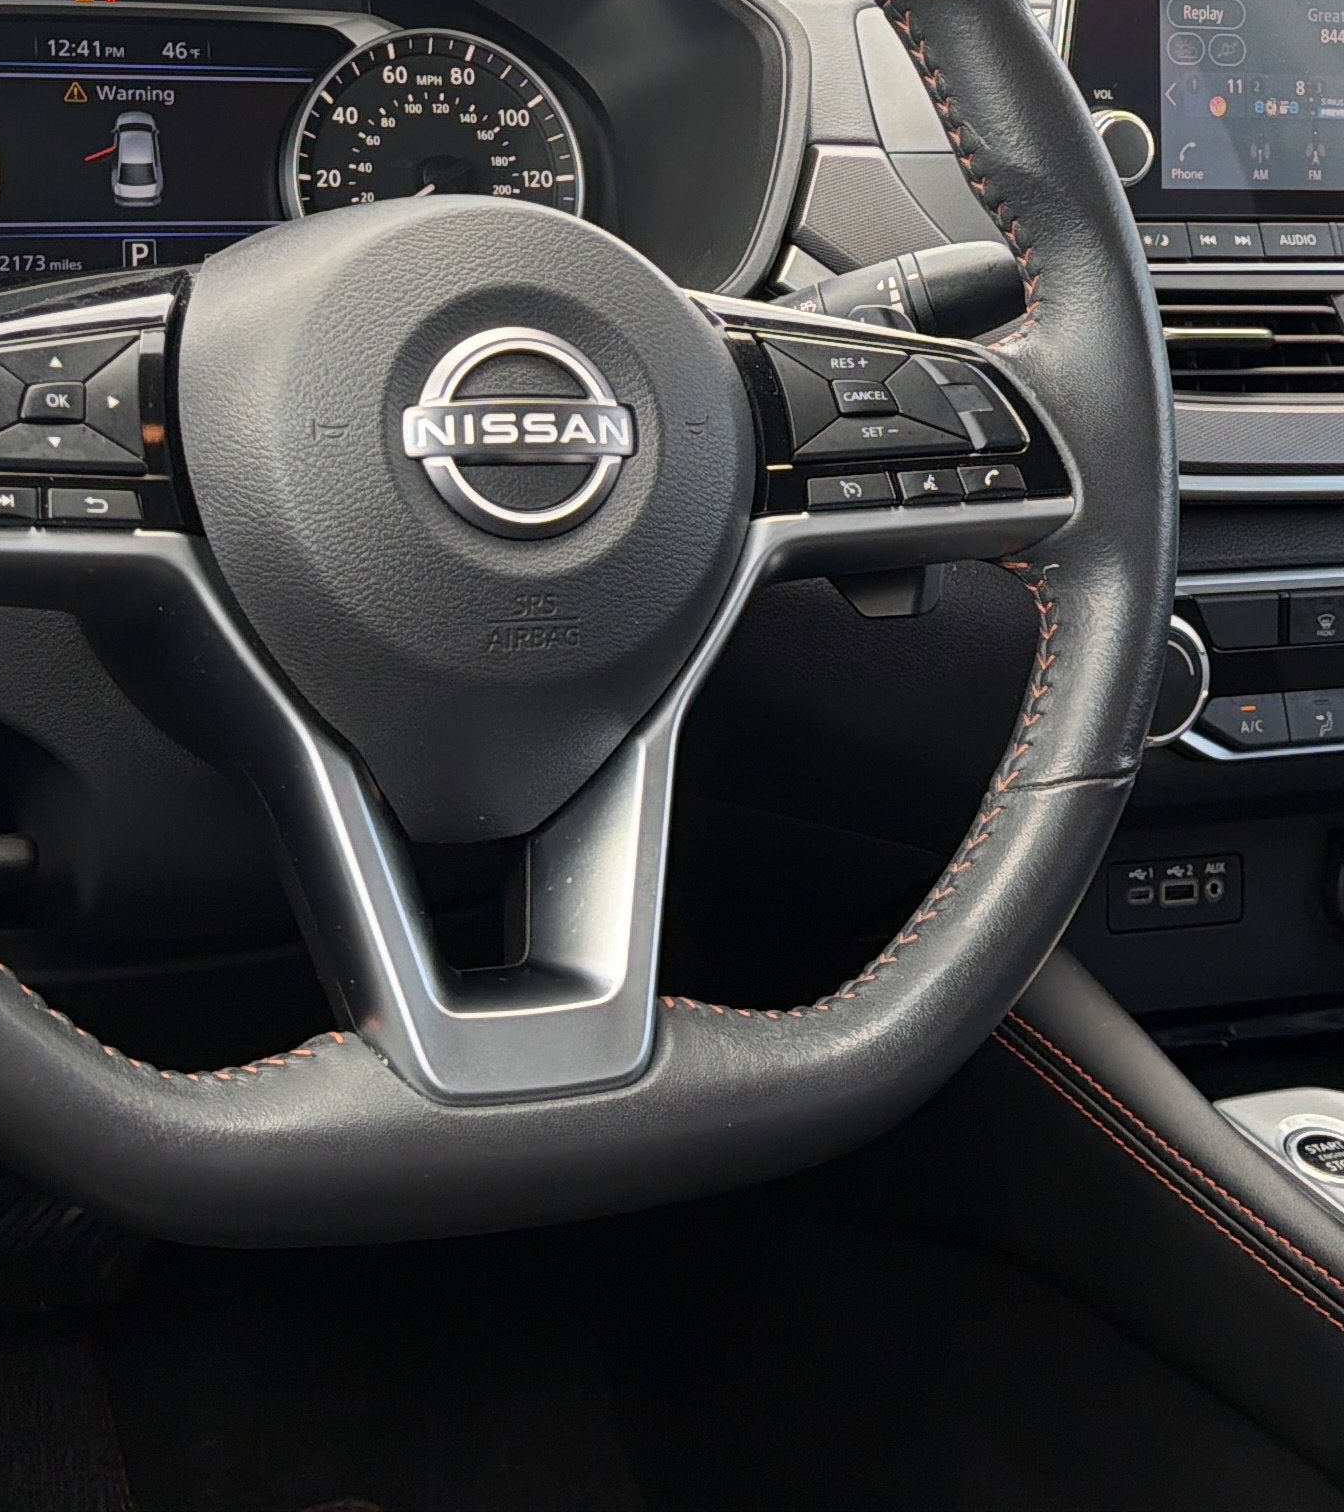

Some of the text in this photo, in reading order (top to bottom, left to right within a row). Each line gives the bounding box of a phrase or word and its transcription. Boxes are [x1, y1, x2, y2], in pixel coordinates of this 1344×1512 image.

[1183, 4, 1225, 24] Replay
[46, 39, 125, 59] 12:41 PM
[382, 66, 408, 85] 60
[416, 74, 443, 87] MPH
[450, 67, 476, 87] 80
[1227, 78, 1244, 94] 11
[1295, 80, 1306, 96] 8
[96, 85, 176, 107] Warning
[1093, 89, 1115, 100] VOL
[404, 102, 423, 115] 100
[431, 102, 450, 115] 120
[331, 106, 359, 125] 40
[459, 112, 478, 125] 140
[497, 109, 531, 128] 100
[380, 116, 396, 129] 80
[365, 134, 381, 147] 60
[476, 130, 495, 143] 160
[357, 161, 373, 174] 40
[490, 155, 509, 168] 180
[316, 169, 342, 188] 20
[522, 169, 554, 189] 120
[1171, 168, 1204, 181] Phone
[1253, 170, 1269, 181] AM
[1308, 170, 1322, 181] FM
[492, 183, 513, 197] 200
[359, 191, 375, 204] 20
[1280, 234, 1317, 246] AUDIO
[131, 243, 151, 266] P
[49, 257, 83, 272] miles
[831, 357, 855, 369] RES
[46, 394, 69, 408] OK
[843, 390, 888, 402] CANCEL
[416, 412, 629, 448] NISSAN
[861, 426, 884, 438] SET
[510, 594, 558, 619] SRS
[487, 626, 580, 652] AIRBAG
[1240, 720, 1263, 735] A/C
[1186, 864, 1193, 876] 2
[1204, 862, 1226, 874] AUX
[1305, 1141, 1344, 1155] START
